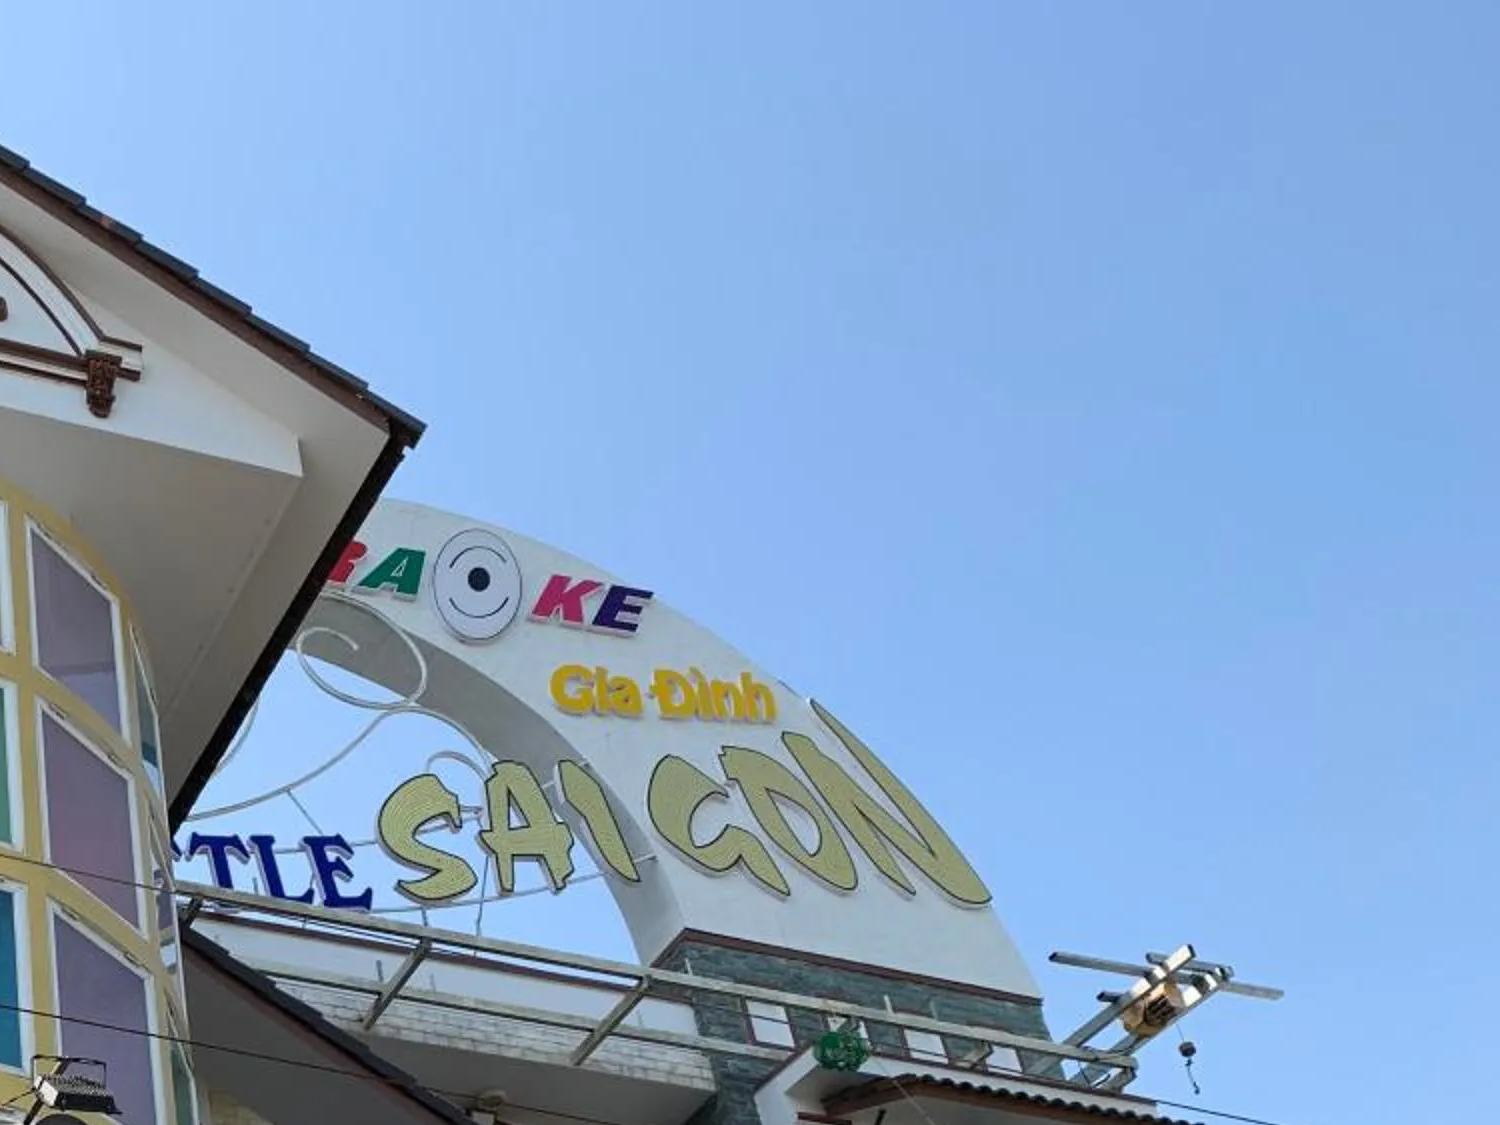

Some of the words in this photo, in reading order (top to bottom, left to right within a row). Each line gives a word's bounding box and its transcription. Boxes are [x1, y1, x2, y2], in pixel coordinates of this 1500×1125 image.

[550, 664, 643, 717] Gia
[171, 832, 373, 910] TLE
[378, 759, 641, 902] SAI
[647, 698, 992, 908] GON
